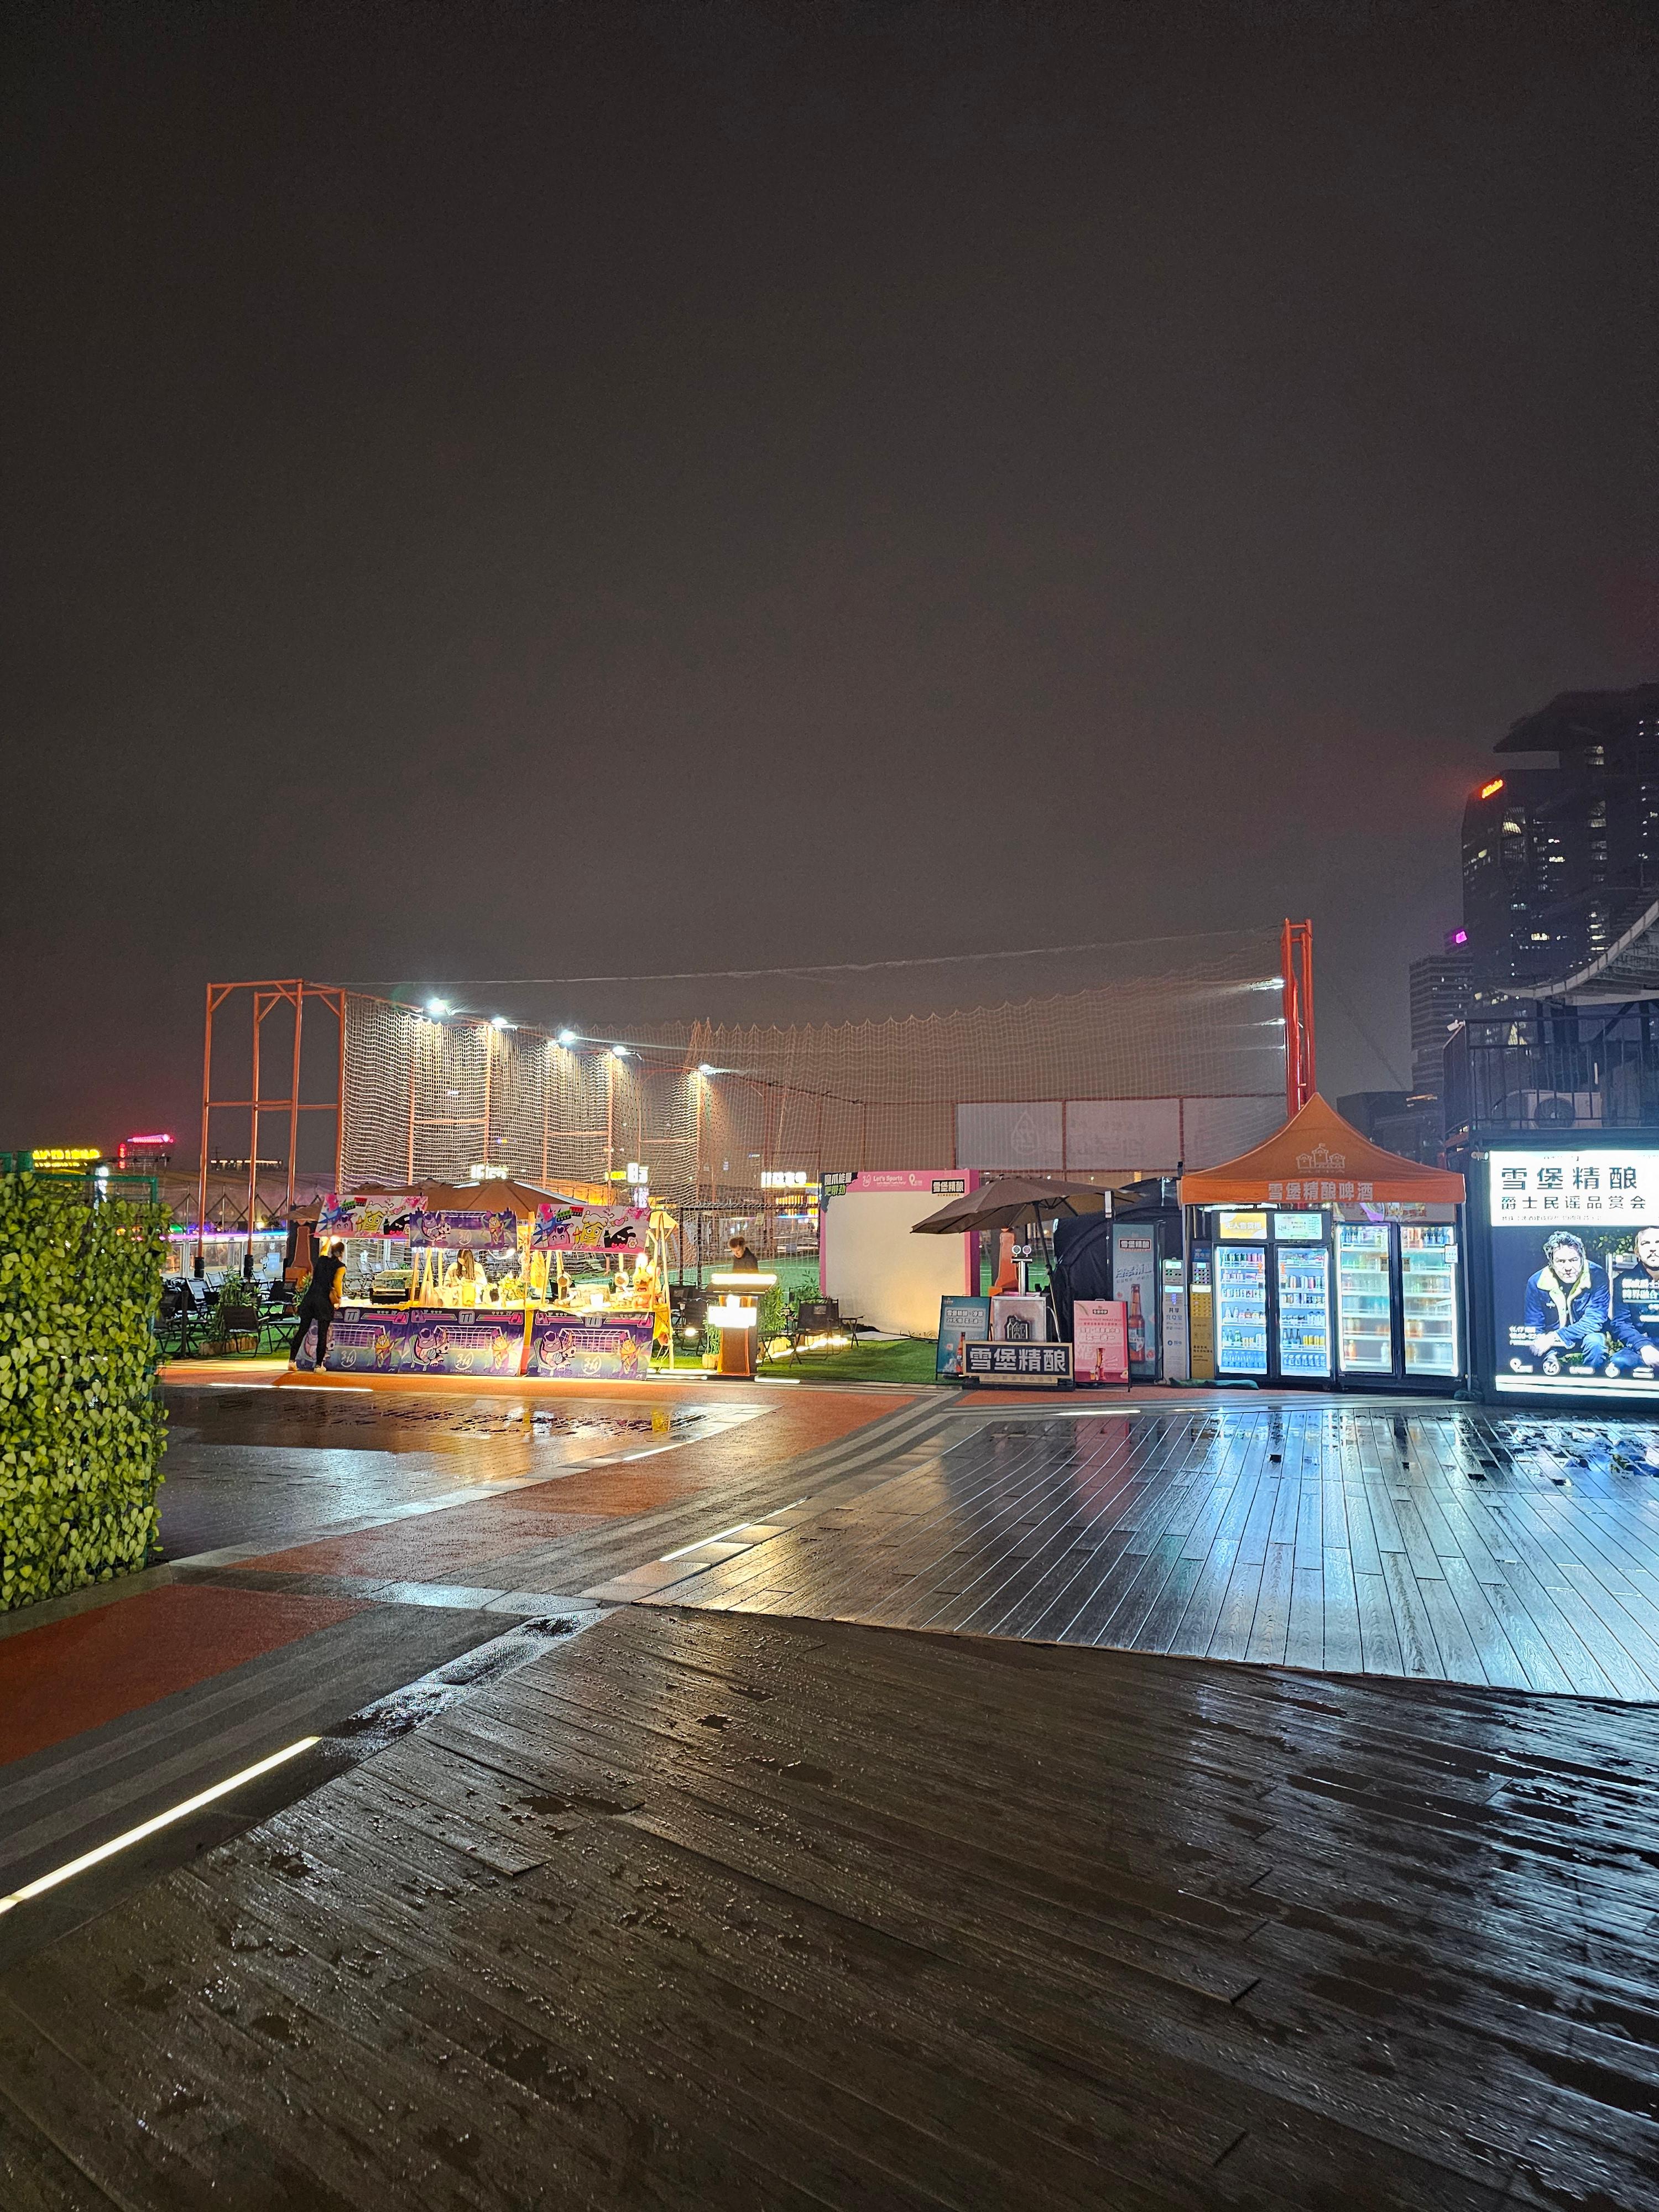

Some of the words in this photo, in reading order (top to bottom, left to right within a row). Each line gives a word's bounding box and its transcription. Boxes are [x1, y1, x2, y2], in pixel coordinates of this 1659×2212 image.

[1501, 1166, 1637, 1190] 雪堡精酿
[1268, 1181, 1373, 1201] 雪堡精酿啤酒
[1501, 1196, 1646, 1209] 爵士民谣品赏会
[970, 1348, 1066, 1372] 雪堡精酿
